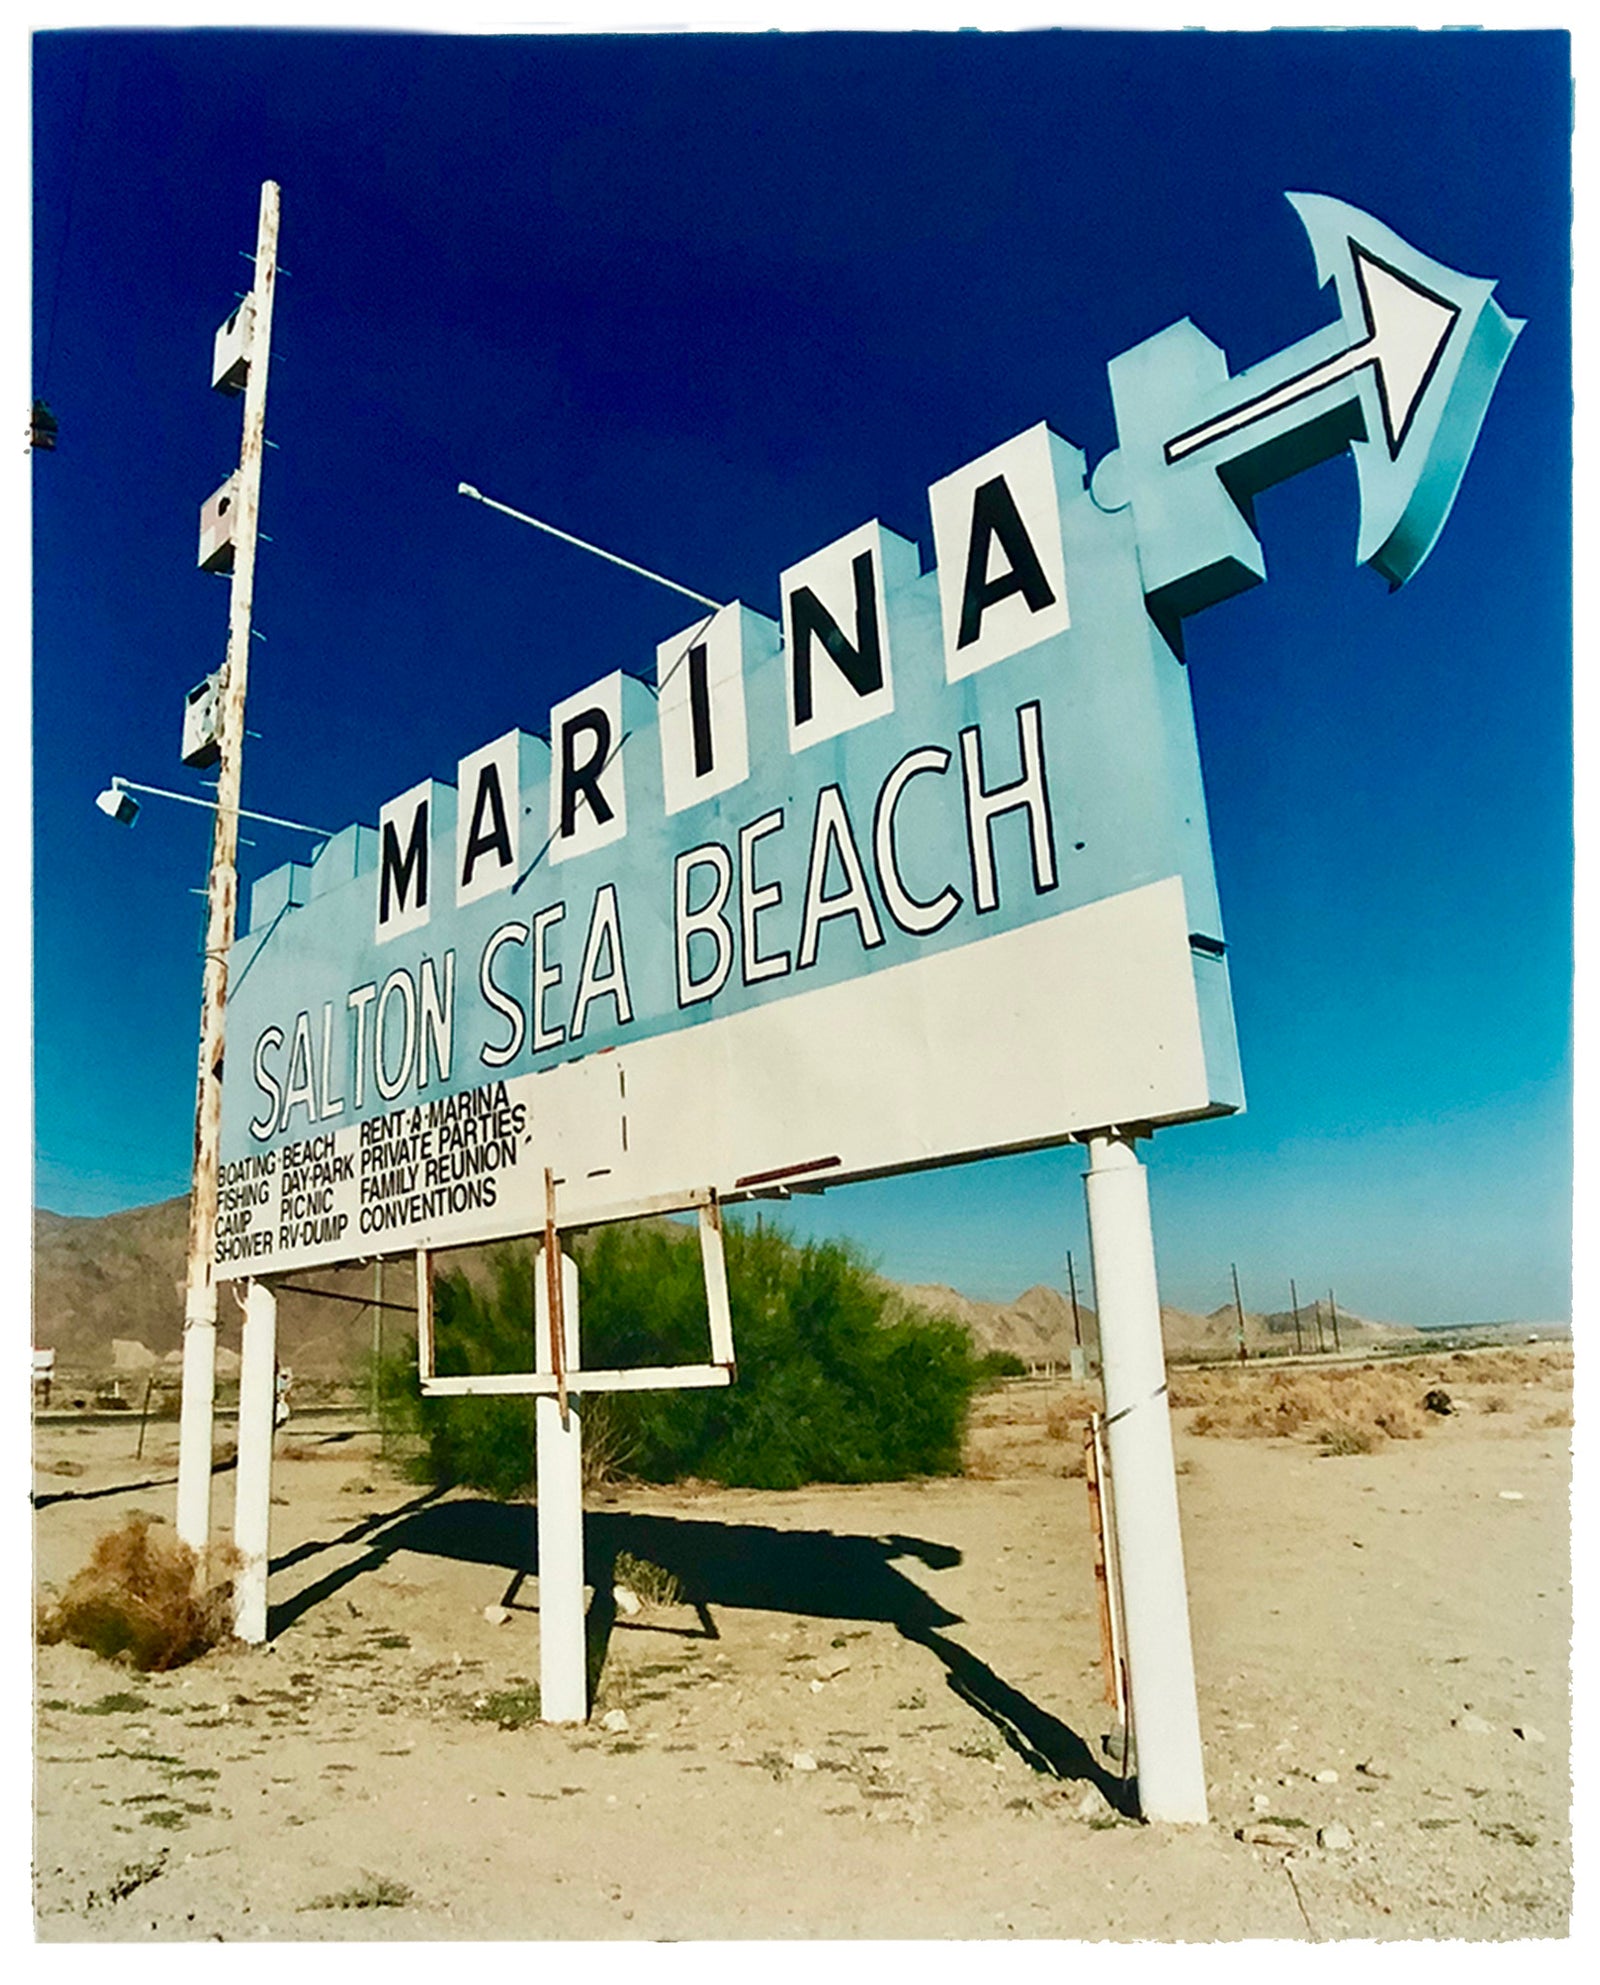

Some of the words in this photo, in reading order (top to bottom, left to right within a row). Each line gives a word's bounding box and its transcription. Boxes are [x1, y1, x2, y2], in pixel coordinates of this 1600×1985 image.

[379, 474, 1057, 925] MARINA
[249, 950, 455, 1141] SALTON
[480, 883, 634, 1068] SEA
[674, 700, 1059, 1008] BEACH
[282, 1131, 335, 1170] BEACH
[361, 1131, 432, 1175] PRIVATE
[438, 1103, 527, 1154] PARTIES
[361, 1163, 419, 1205] FAMILY
[425, 1136, 517, 1188] REUNION
[217, 1180, 269, 1211] FISHING
[280, 1187, 333, 1222] PICNIC
[359, 1176, 497, 1234] CONVENTIONS
[214, 1210, 252, 1239] CAMP
[214, 1230, 273, 1264] SHOWER
